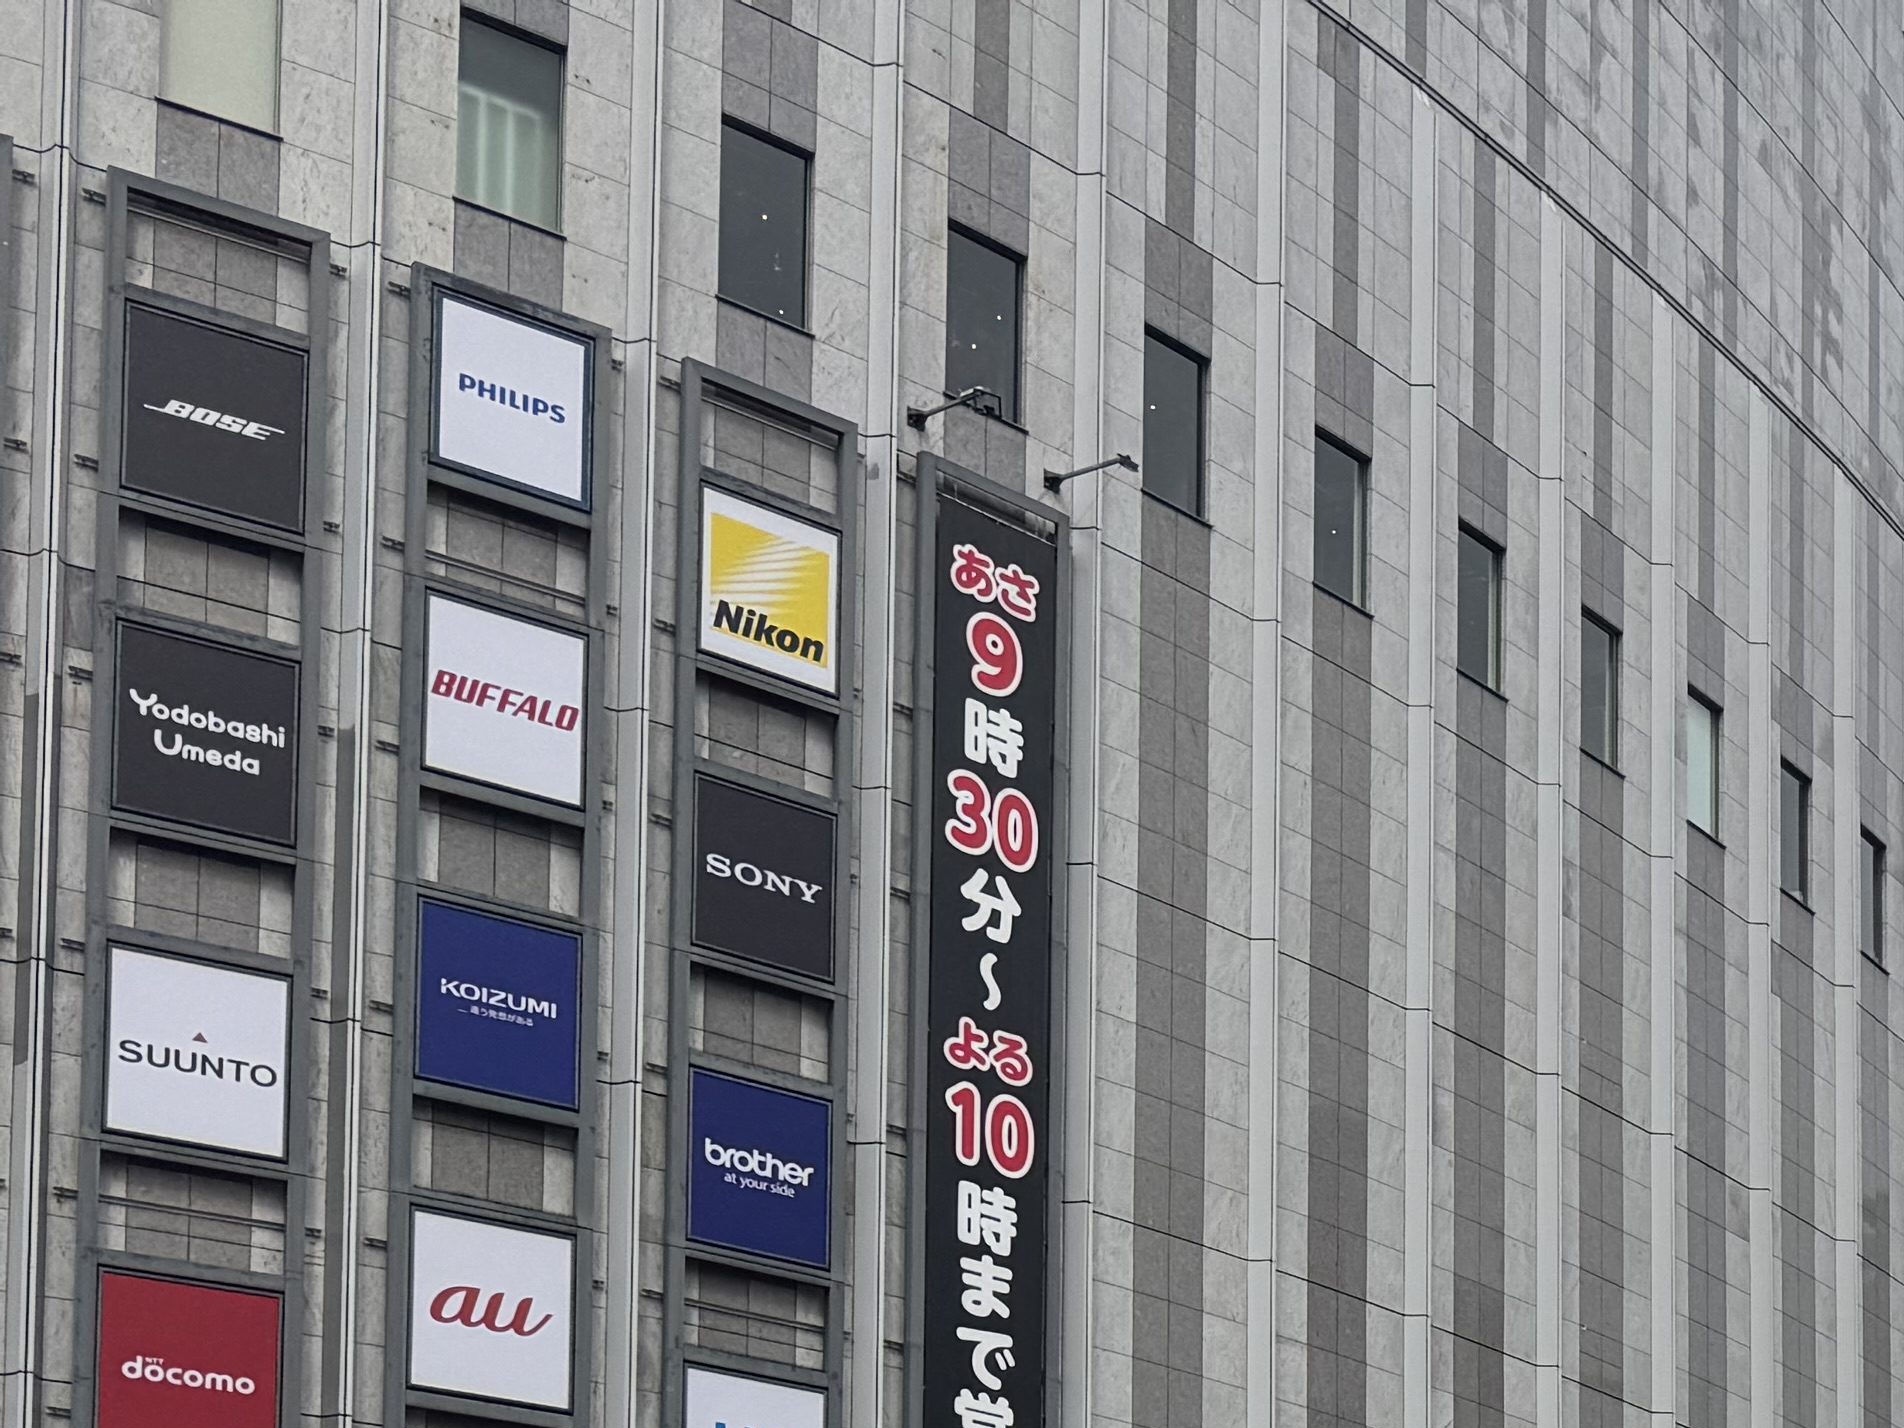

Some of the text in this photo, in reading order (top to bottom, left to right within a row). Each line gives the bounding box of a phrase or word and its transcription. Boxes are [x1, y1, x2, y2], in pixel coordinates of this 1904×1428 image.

[143, 398, 284, 440] BOSE
[456, 371, 567, 426] PHILIPS
[711, 598, 826, 664] Nikon
[129, 686, 286, 750] Yodobashi
[430, 668, 580, 733] BUFFALO
[153, 729, 261, 777] Umeda
[705, 852, 823, 906] SONY
[440, 977, 558, 1019] KOIZUMI
[117, 1038, 279, 1089] SUUNTO
[704, 1137, 815, 1187] brother
[724, 1171, 796, 1199] at your side
[426, 1281, 555, 1339] au
[121, 1354, 256, 1397] docomo
